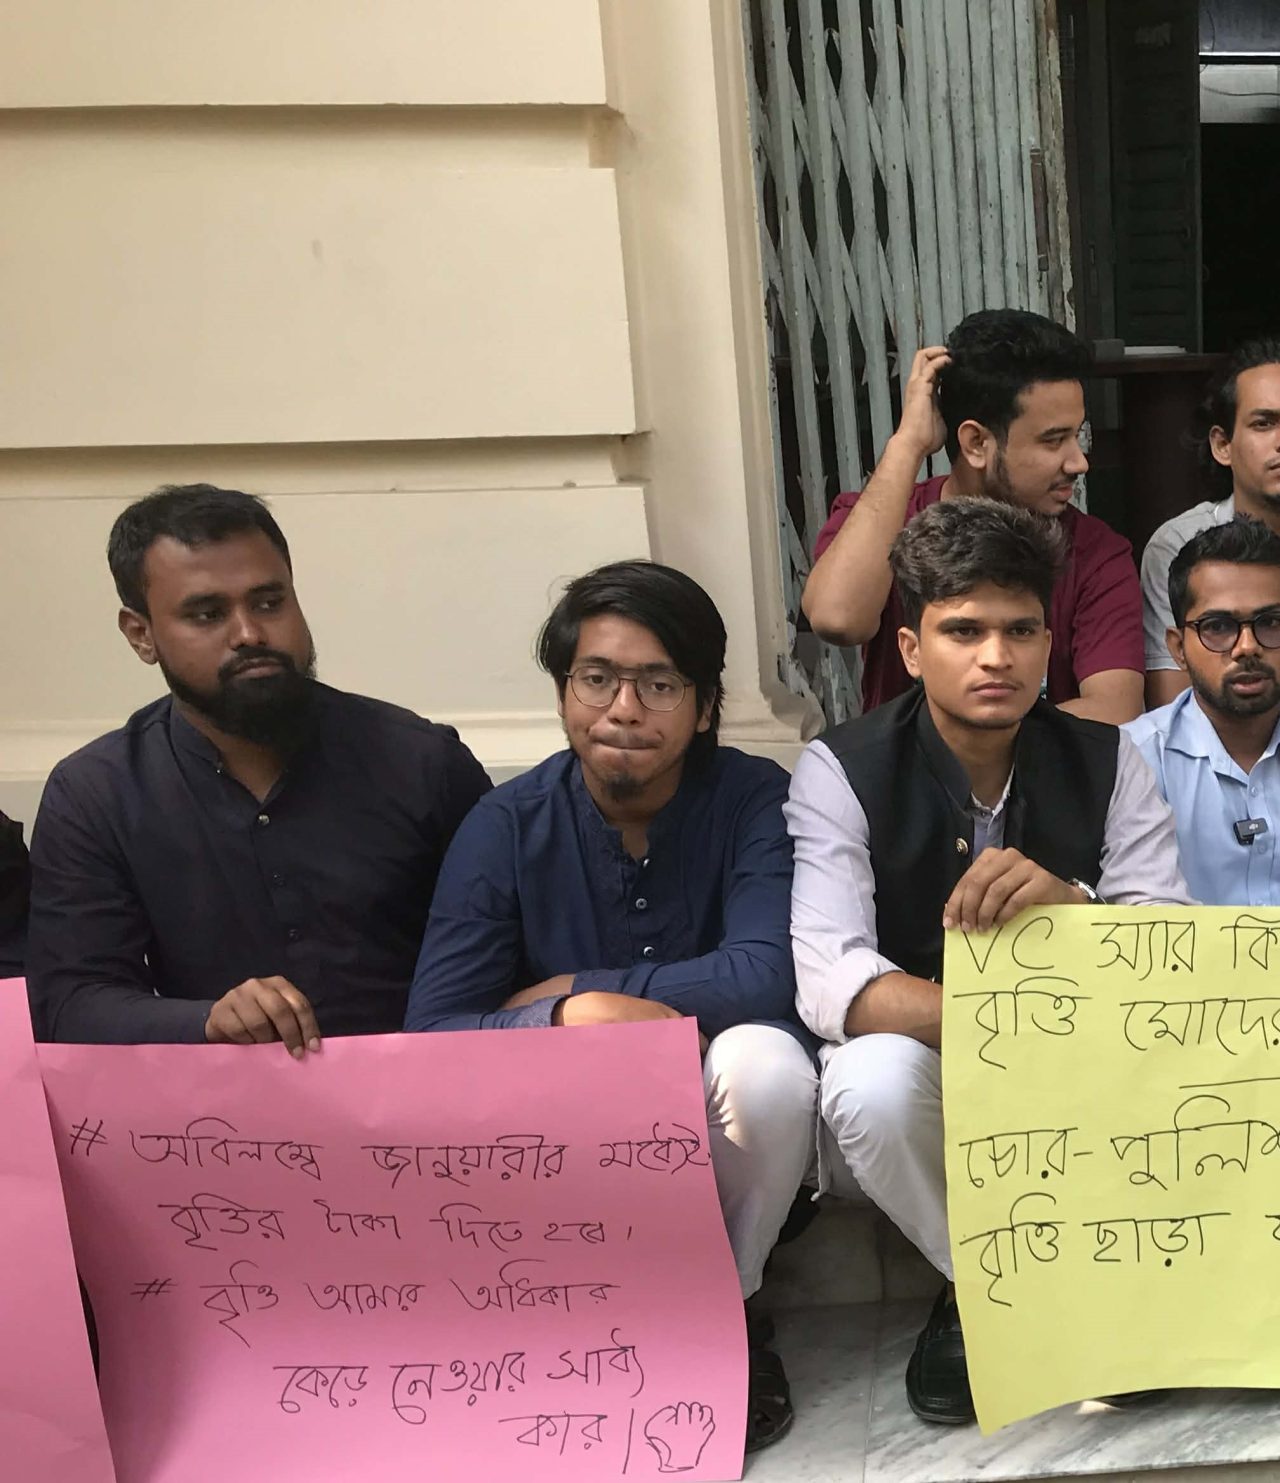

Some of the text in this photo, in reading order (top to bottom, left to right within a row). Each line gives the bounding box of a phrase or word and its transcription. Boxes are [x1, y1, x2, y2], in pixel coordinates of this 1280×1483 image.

[960, 915, 1056, 975] VC
[1090, 920, 1195, 981] স্যার
[952, 976, 1093, 1070] বৃত্তি
[129, 1117, 323, 1181] অবিলম্বে
[158, 1193, 285, 1251] বৃত্তির
[313, 1199, 401, 1239] টাকা
[429, 1203, 522, 1252] দিতে
[959, 1192, 1067, 1308] বৃত্তি
[1082, 1212, 1232, 1267] ছাড়া
[200, 1260, 278, 1348] বৃত্তি
[306, 1284, 425, 1314] আমার
[450, 1259, 620, 1312] অধিকার
[273, 1328, 644, 1425] কেড়ে নেওয়ার সাধ্য
